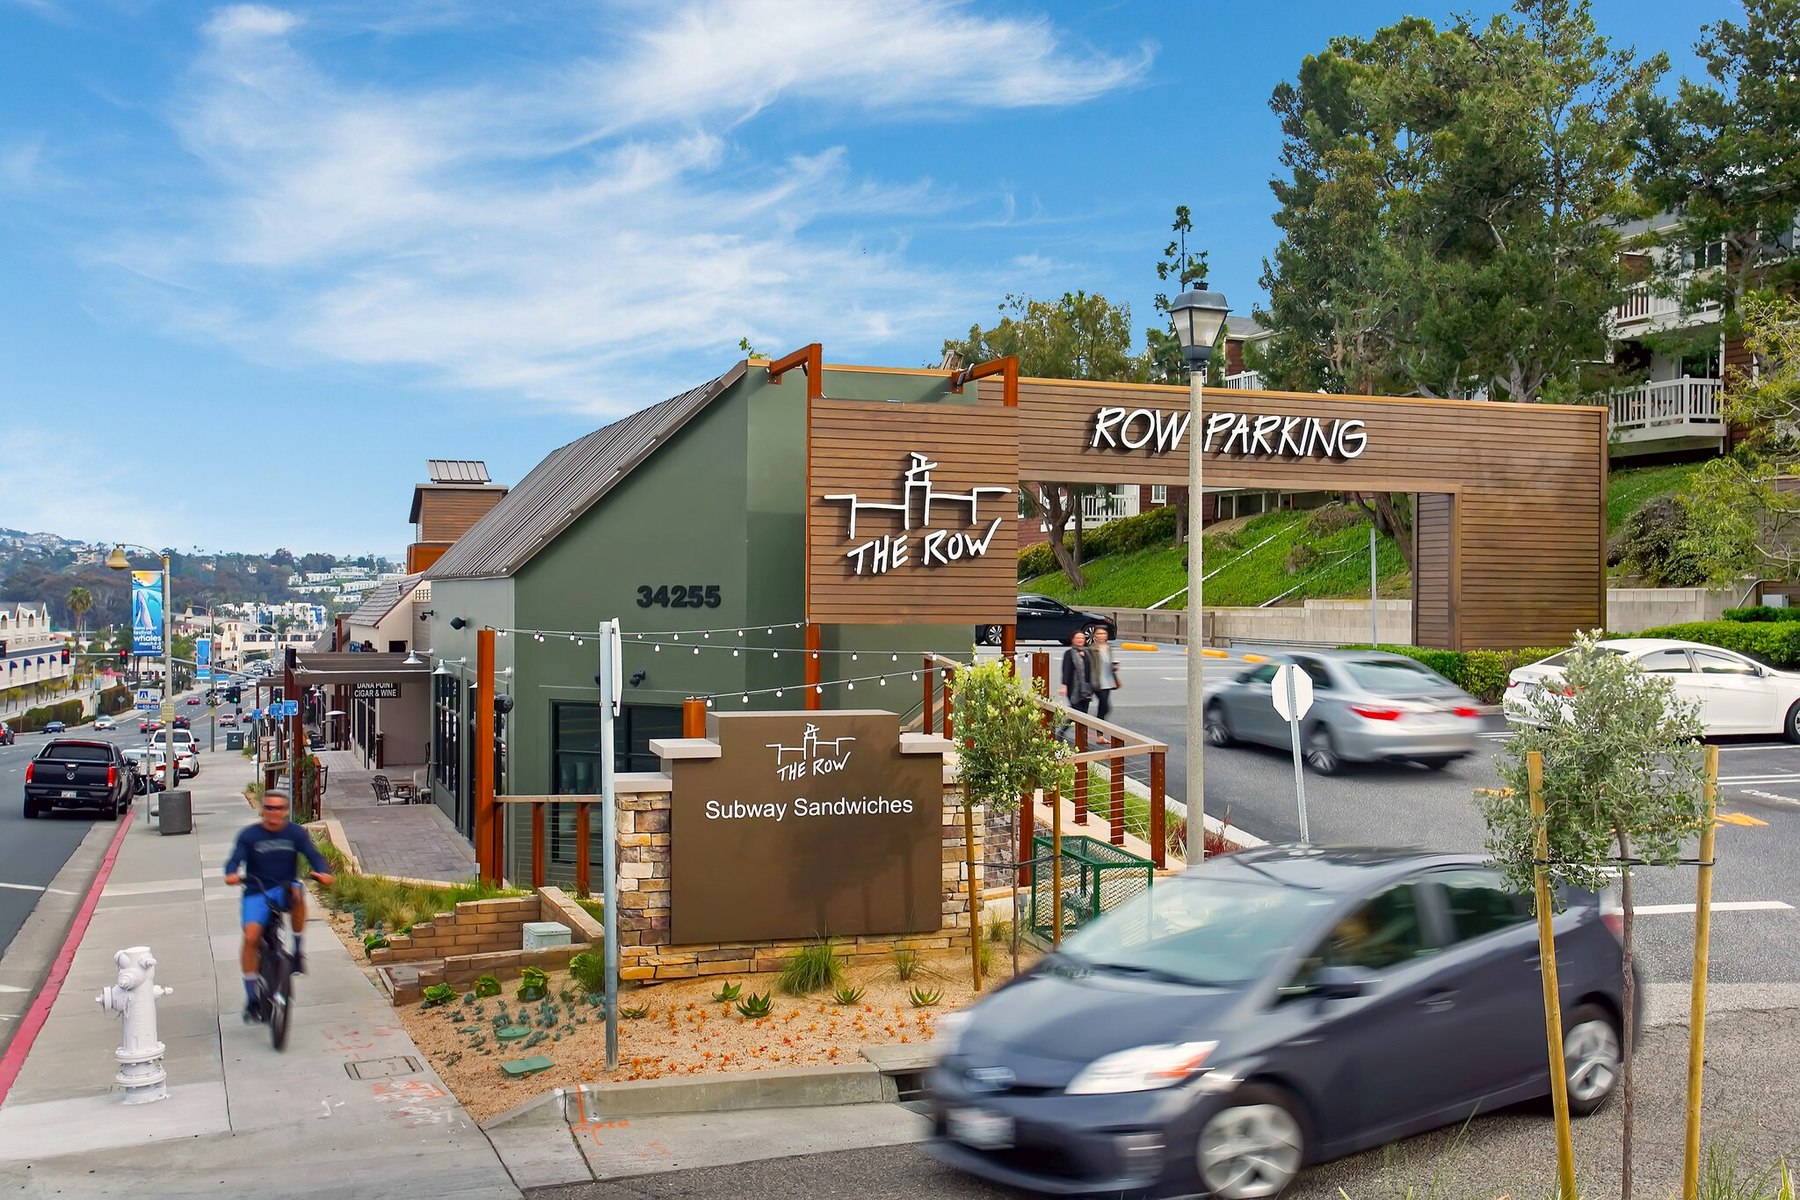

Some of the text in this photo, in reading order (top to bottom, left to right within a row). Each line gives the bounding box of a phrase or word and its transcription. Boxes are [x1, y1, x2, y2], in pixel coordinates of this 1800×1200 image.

[1091, 407, 1368, 458] ROW PARKING
[847, 516, 1002, 575] THE ROW
[636, 585, 722, 609] 34255
[354, 689, 397, 698] CIGAR & WINE
[776, 751, 851, 782] THE ROW
[705, 796, 914, 822] Subway Sandwiches
